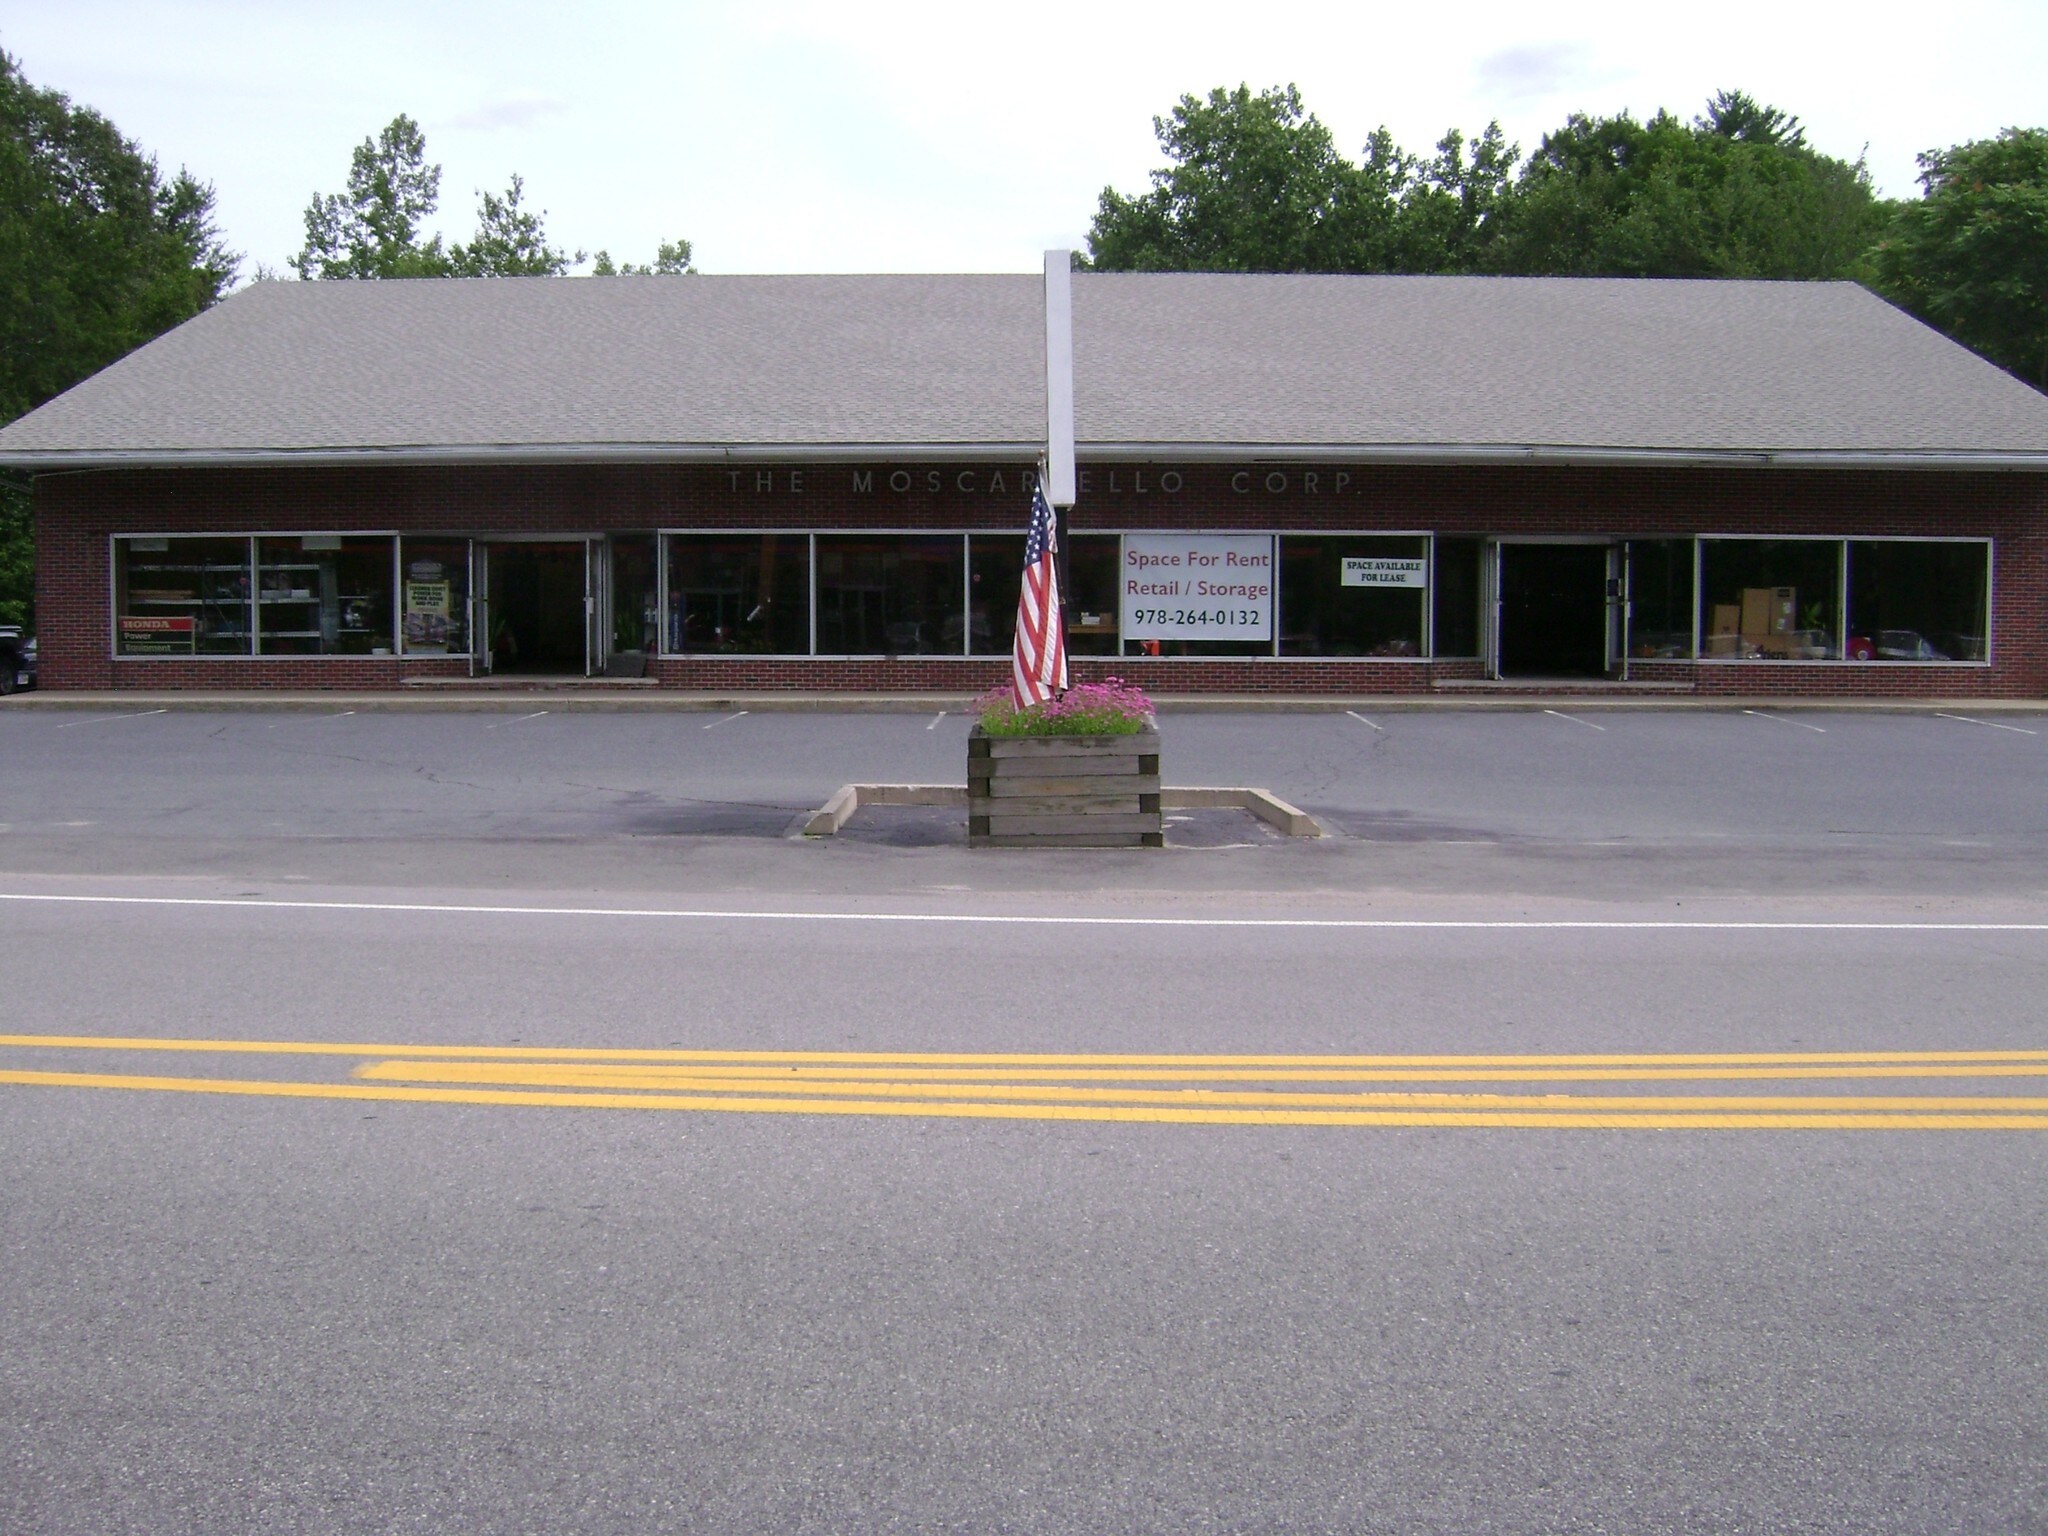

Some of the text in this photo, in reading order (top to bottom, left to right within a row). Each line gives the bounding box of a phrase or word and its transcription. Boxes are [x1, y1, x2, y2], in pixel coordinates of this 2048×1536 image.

[727, 471, 804, 492] THE
[853, 471, 1182, 493] MOSCARELLO
[1127, 551, 1269, 570] Space For Rent
[1346, 561, 1421, 571] SPACE AVAILABLE
[1361, 573, 1406, 582] FOR LEASE
[1127, 580, 1179, 595] Retail
[1198, 581, 1268, 600] Storage
[1135, 610, 1259, 625] 978-264-0132
[123, 620, 170, 629] HONDA
[124, 632, 151, 640] Power
